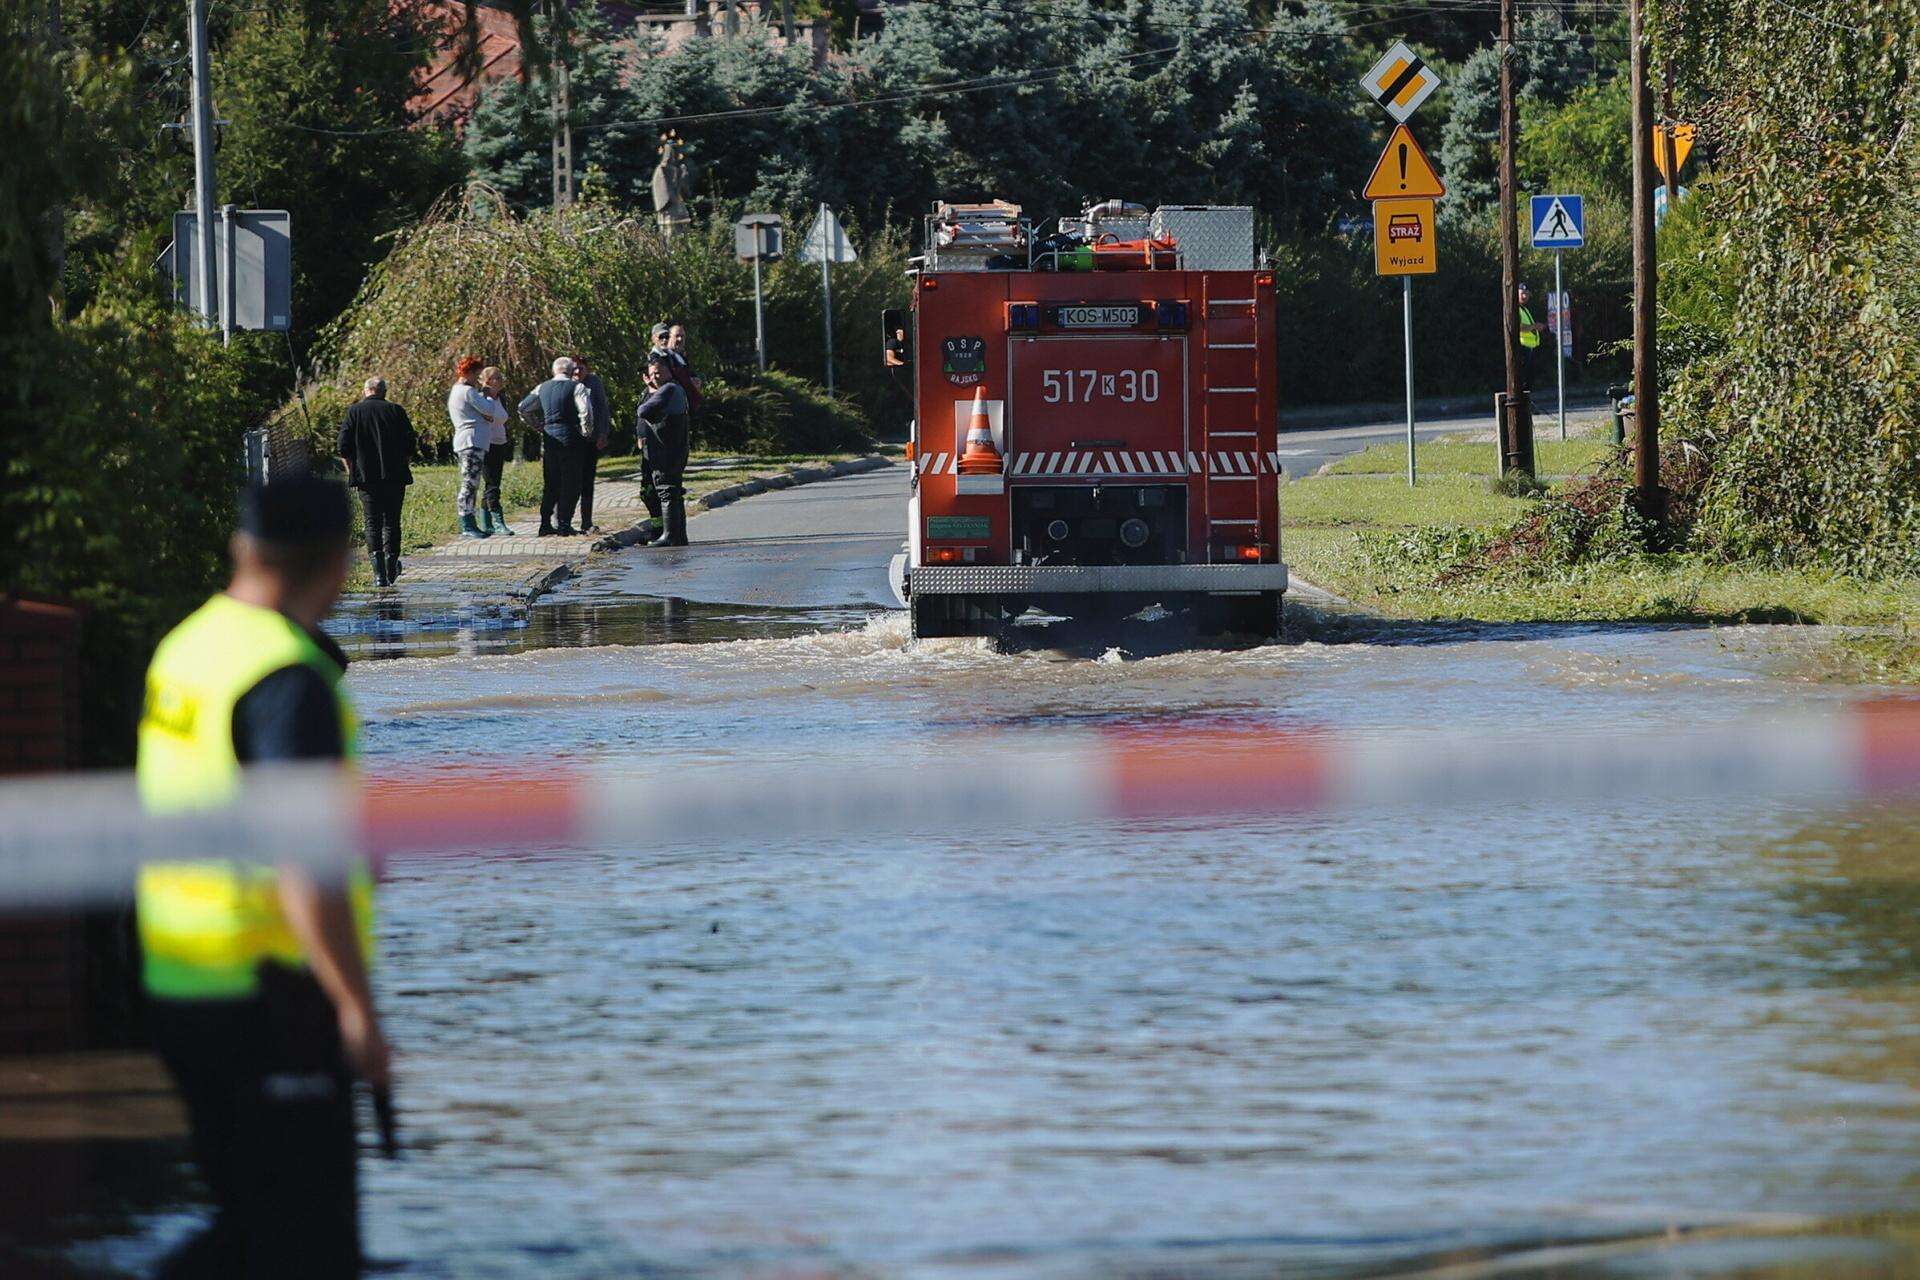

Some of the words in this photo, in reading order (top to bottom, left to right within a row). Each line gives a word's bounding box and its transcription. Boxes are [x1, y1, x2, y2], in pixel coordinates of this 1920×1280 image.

[1390, 225, 1420, 237] STRAŻ
[1389, 256, 1424, 267] Wyjazd
[1547, 292, 1570, 310] AUO
[947, 339, 982, 351] OSP
[1043, 369, 1097, 403] 517
[1119, 369, 1159, 402] 30
